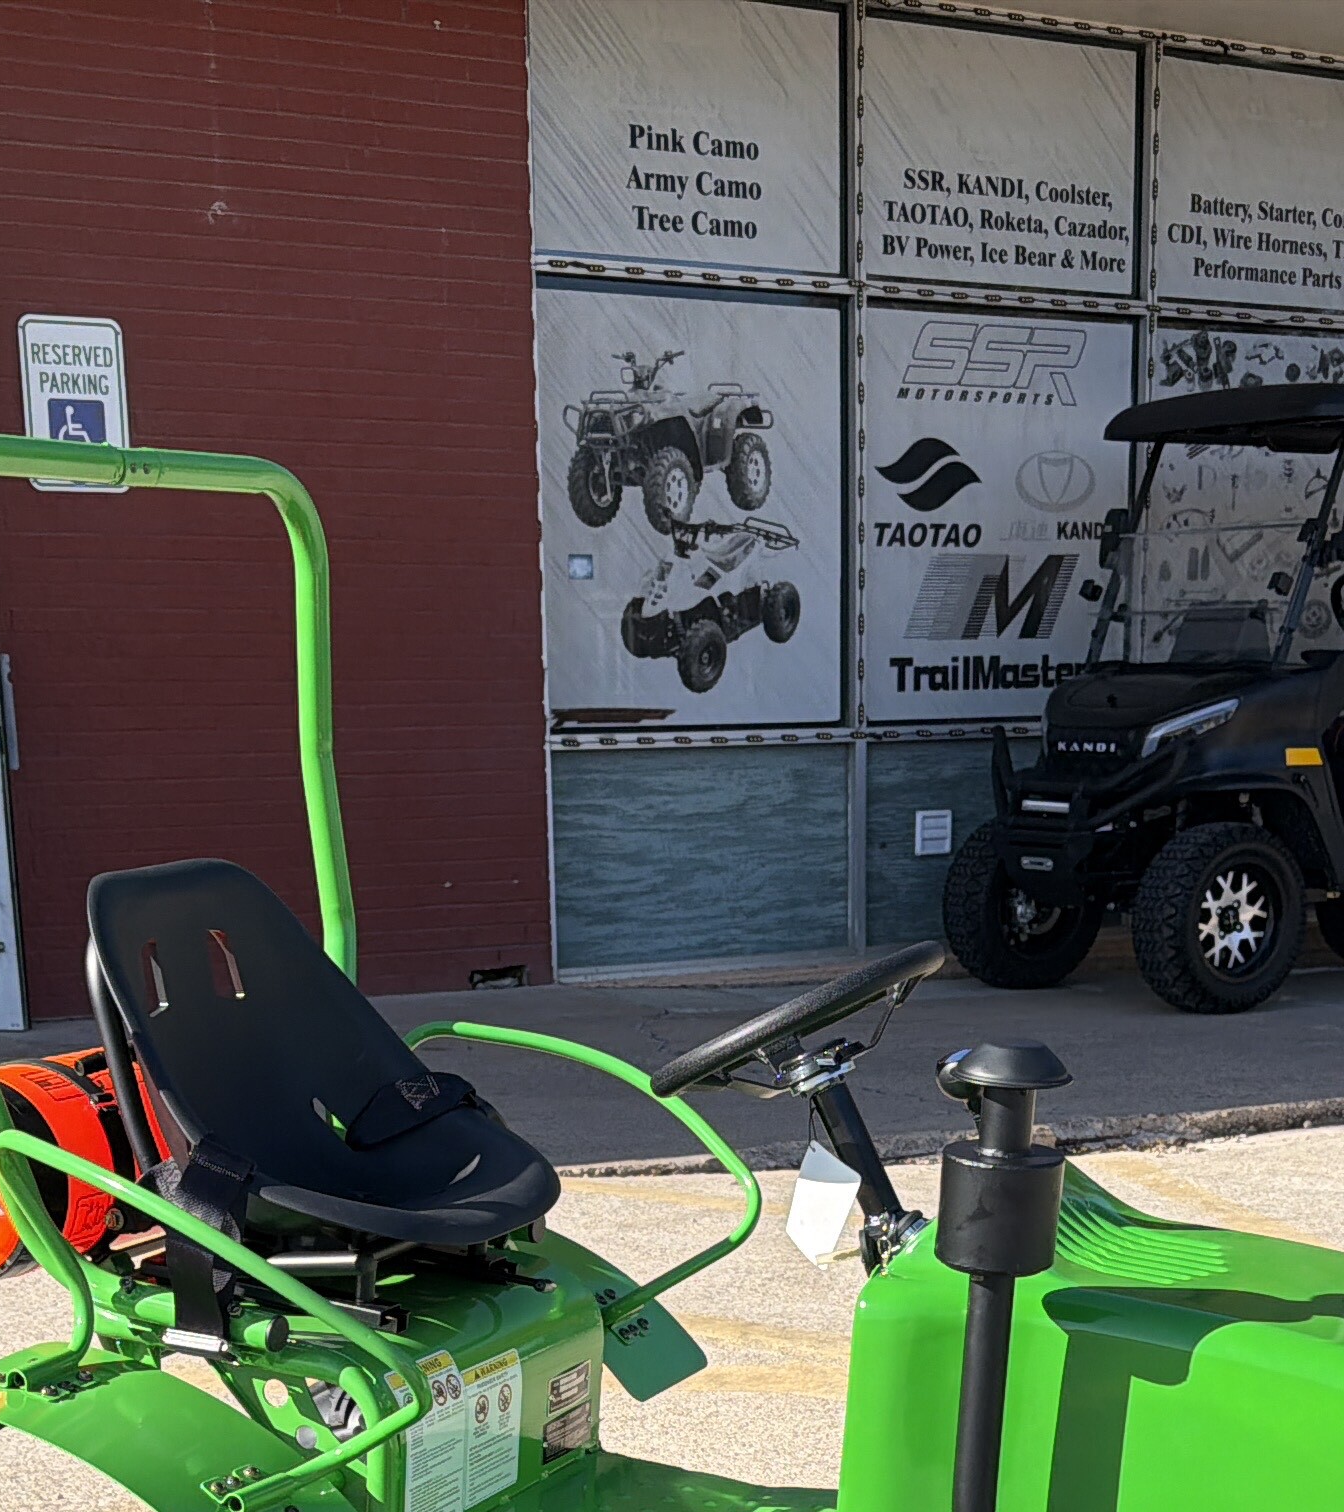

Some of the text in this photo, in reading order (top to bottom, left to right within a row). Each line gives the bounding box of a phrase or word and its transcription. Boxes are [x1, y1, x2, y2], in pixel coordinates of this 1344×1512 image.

[629, 124, 759, 160] Pink Camo
[626, 165, 762, 200] Army Camo
[903, 168, 1113, 212] SSR, KANDI, Coolster,
[632, 205, 757, 239] Tree Camo
[883, 200, 1129, 246] TAOTAO, Roketa, Cazador,
[1190, 193, 1253, 224] Battery,
[1257, 200, 1316, 230] Starter,
[882, 234, 1126, 273] BV Power, Ice Bear & More
[1167, 223, 1207, 250] CDI,
[1213, 227, 1252, 250] Wire
[1257, 232, 1327, 262] Horness,
[1193, 257, 1342, 290] Performance Parts
[30, 343, 113, 368] RESERVED
[902, 320, 1087, 406] SSR
[39, 371, 110, 396] PARKING
[896, 387, 1054, 406] MOTORSPORTS
[874, 522, 982, 548] TAOTAO
[1057, 521, 1104, 541] KAND
[1057, 741, 1116, 753] KANDI
